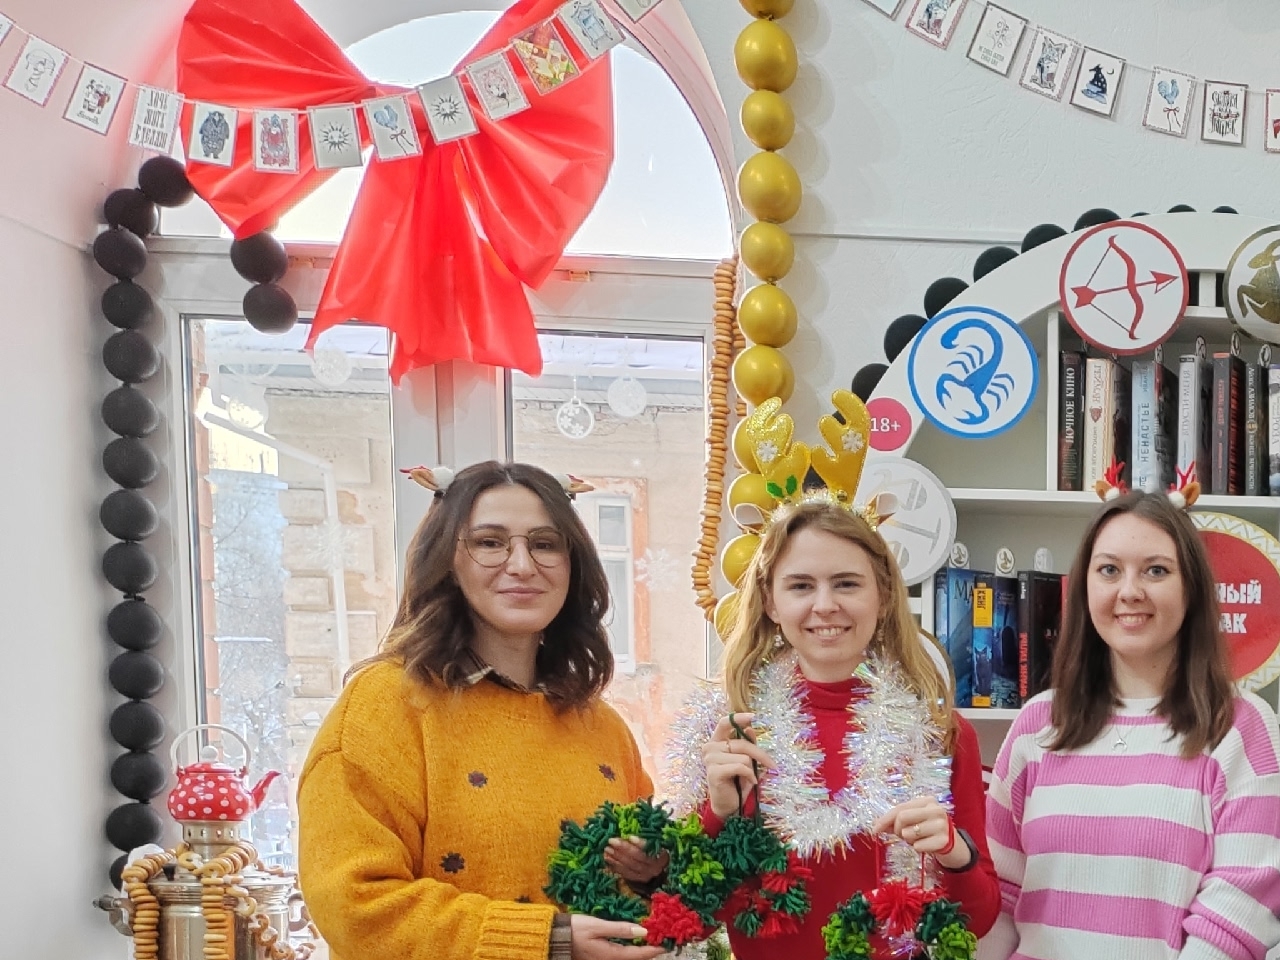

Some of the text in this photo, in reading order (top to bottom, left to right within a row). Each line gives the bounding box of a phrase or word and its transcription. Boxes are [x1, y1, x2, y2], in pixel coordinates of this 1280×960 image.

[1065, 367, 1075, 397] КИНО
[870, 417, 901, 432] 18+
[1065, 400, 1075, 444] НОЧНОЕ
[1140, 402, 1150, 463] НЕНАСТЬЕ
[1019, 632, 1028, 697] ФРАНК ТИЛЬЕ
